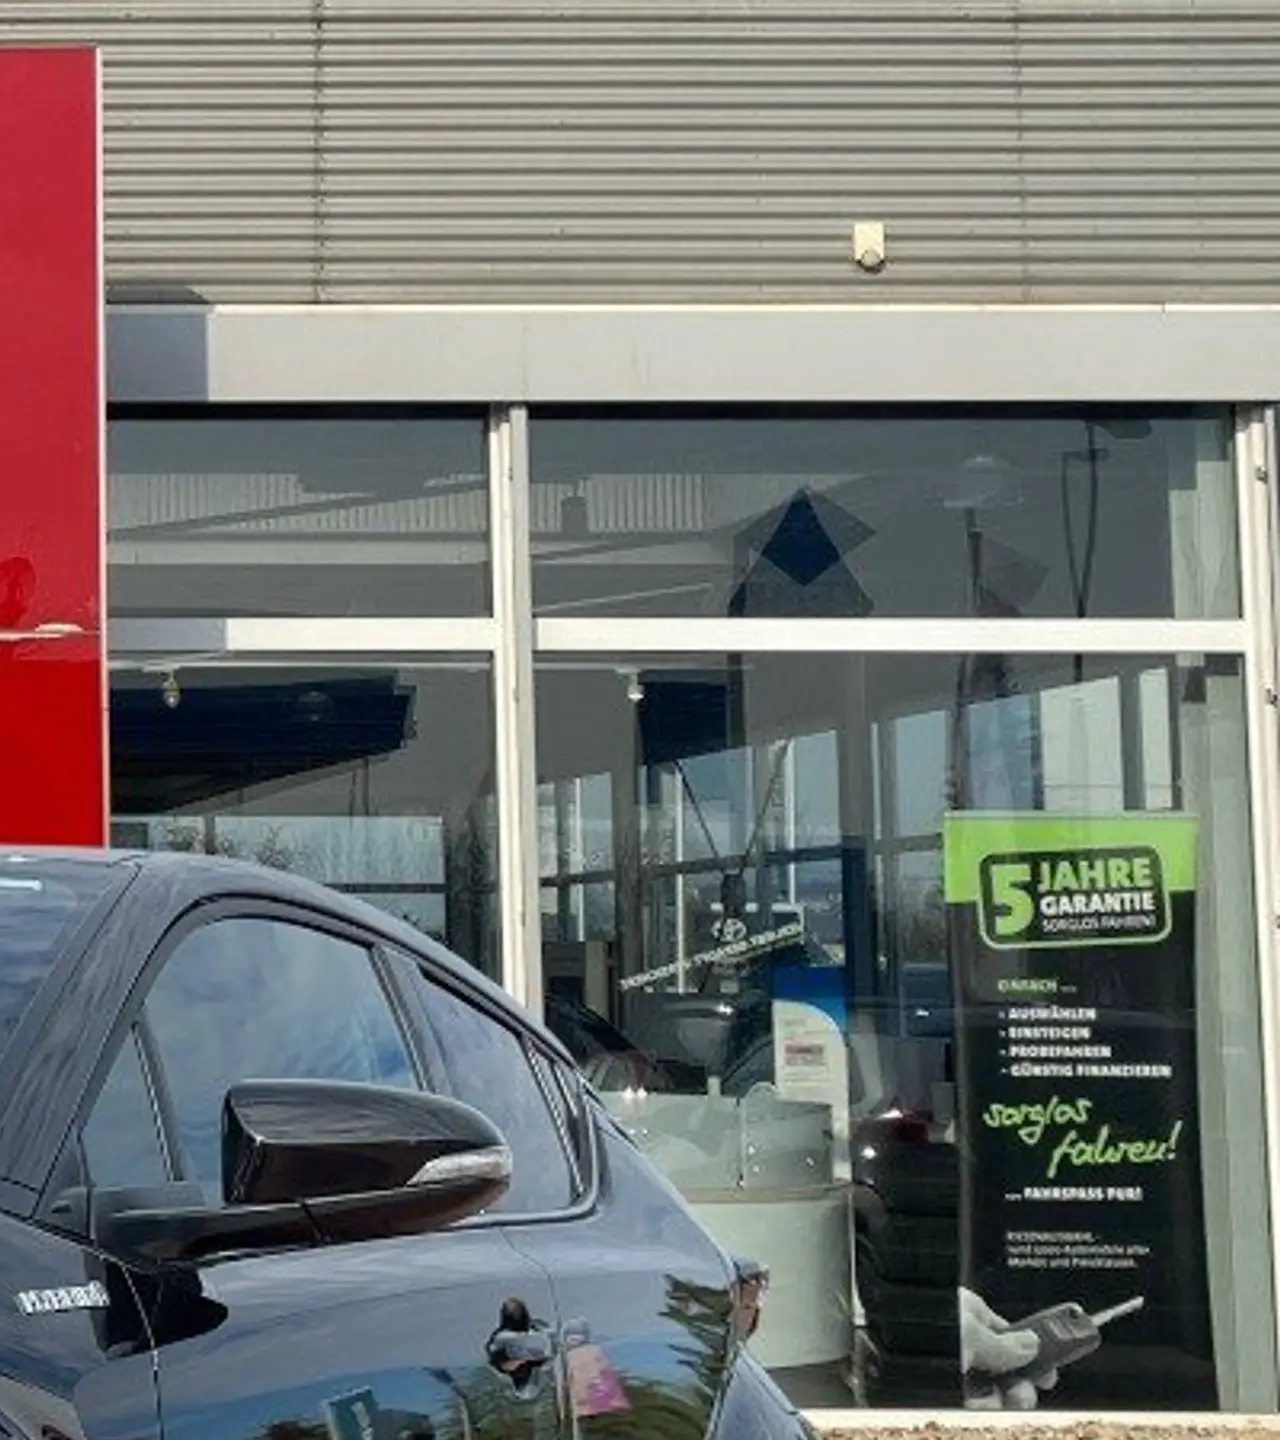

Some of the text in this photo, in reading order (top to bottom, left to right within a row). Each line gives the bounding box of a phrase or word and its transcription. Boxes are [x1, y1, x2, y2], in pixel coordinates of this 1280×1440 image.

[991, 856, 1153, 936] 5 JAHRE
[1040, 891, 1156, 918] GARANTIE
[1008, 1026, 1091, 1040] EINSTEIGEN
[1009, 1045, 1113, 1058] PROBEFAHREN
[1010, 1061, 1173, 1078] GÜNSTIG FINANZIEREN
[982, 1095, 1093, 1146] sorglos
